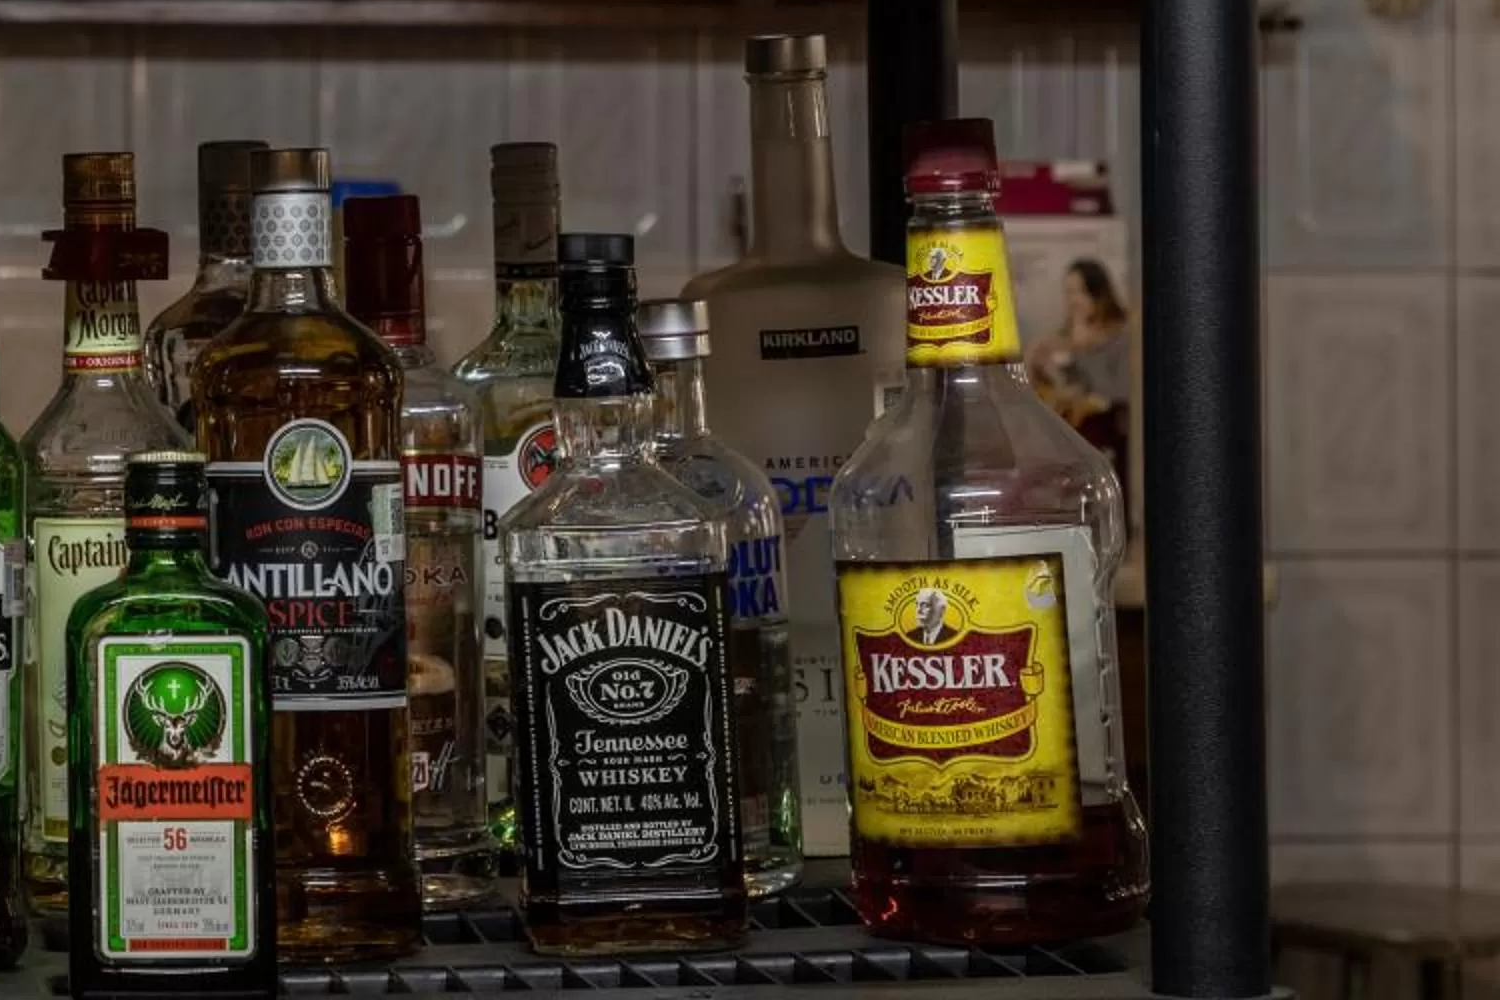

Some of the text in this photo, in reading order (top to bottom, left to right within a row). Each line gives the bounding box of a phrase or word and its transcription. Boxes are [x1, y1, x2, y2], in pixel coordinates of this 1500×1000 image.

[763, 329, 856, 348] KIRKLAND
[766, 456, 854, 469] AMERIC
[407, 464, 476, 497] NOFF
[48, 536, 129, 576] Captain
[227, 562, 394, 597] ANTILLANO
[884, 576, 980, 614] SMOOTH AS SILK
[536, 607, 713, 674] JACK DANIEL'S
[612, 670, 640, 681] Old
[870, 653, 1009, 693] KESSLER
[600, 681, 655, 701] No.7
[575, 730, 688, 753] Tennessee
[917, 727, 971, 744] BLENDED
[974, 711, 1033, 740] WHISKEY
[579, 766, 688, 787] WHISKEY
[105, 775, 248, 809] Jägermeister
[163, 827, 188, 851] 56
[598, 830, 639, 840] DANIEL
